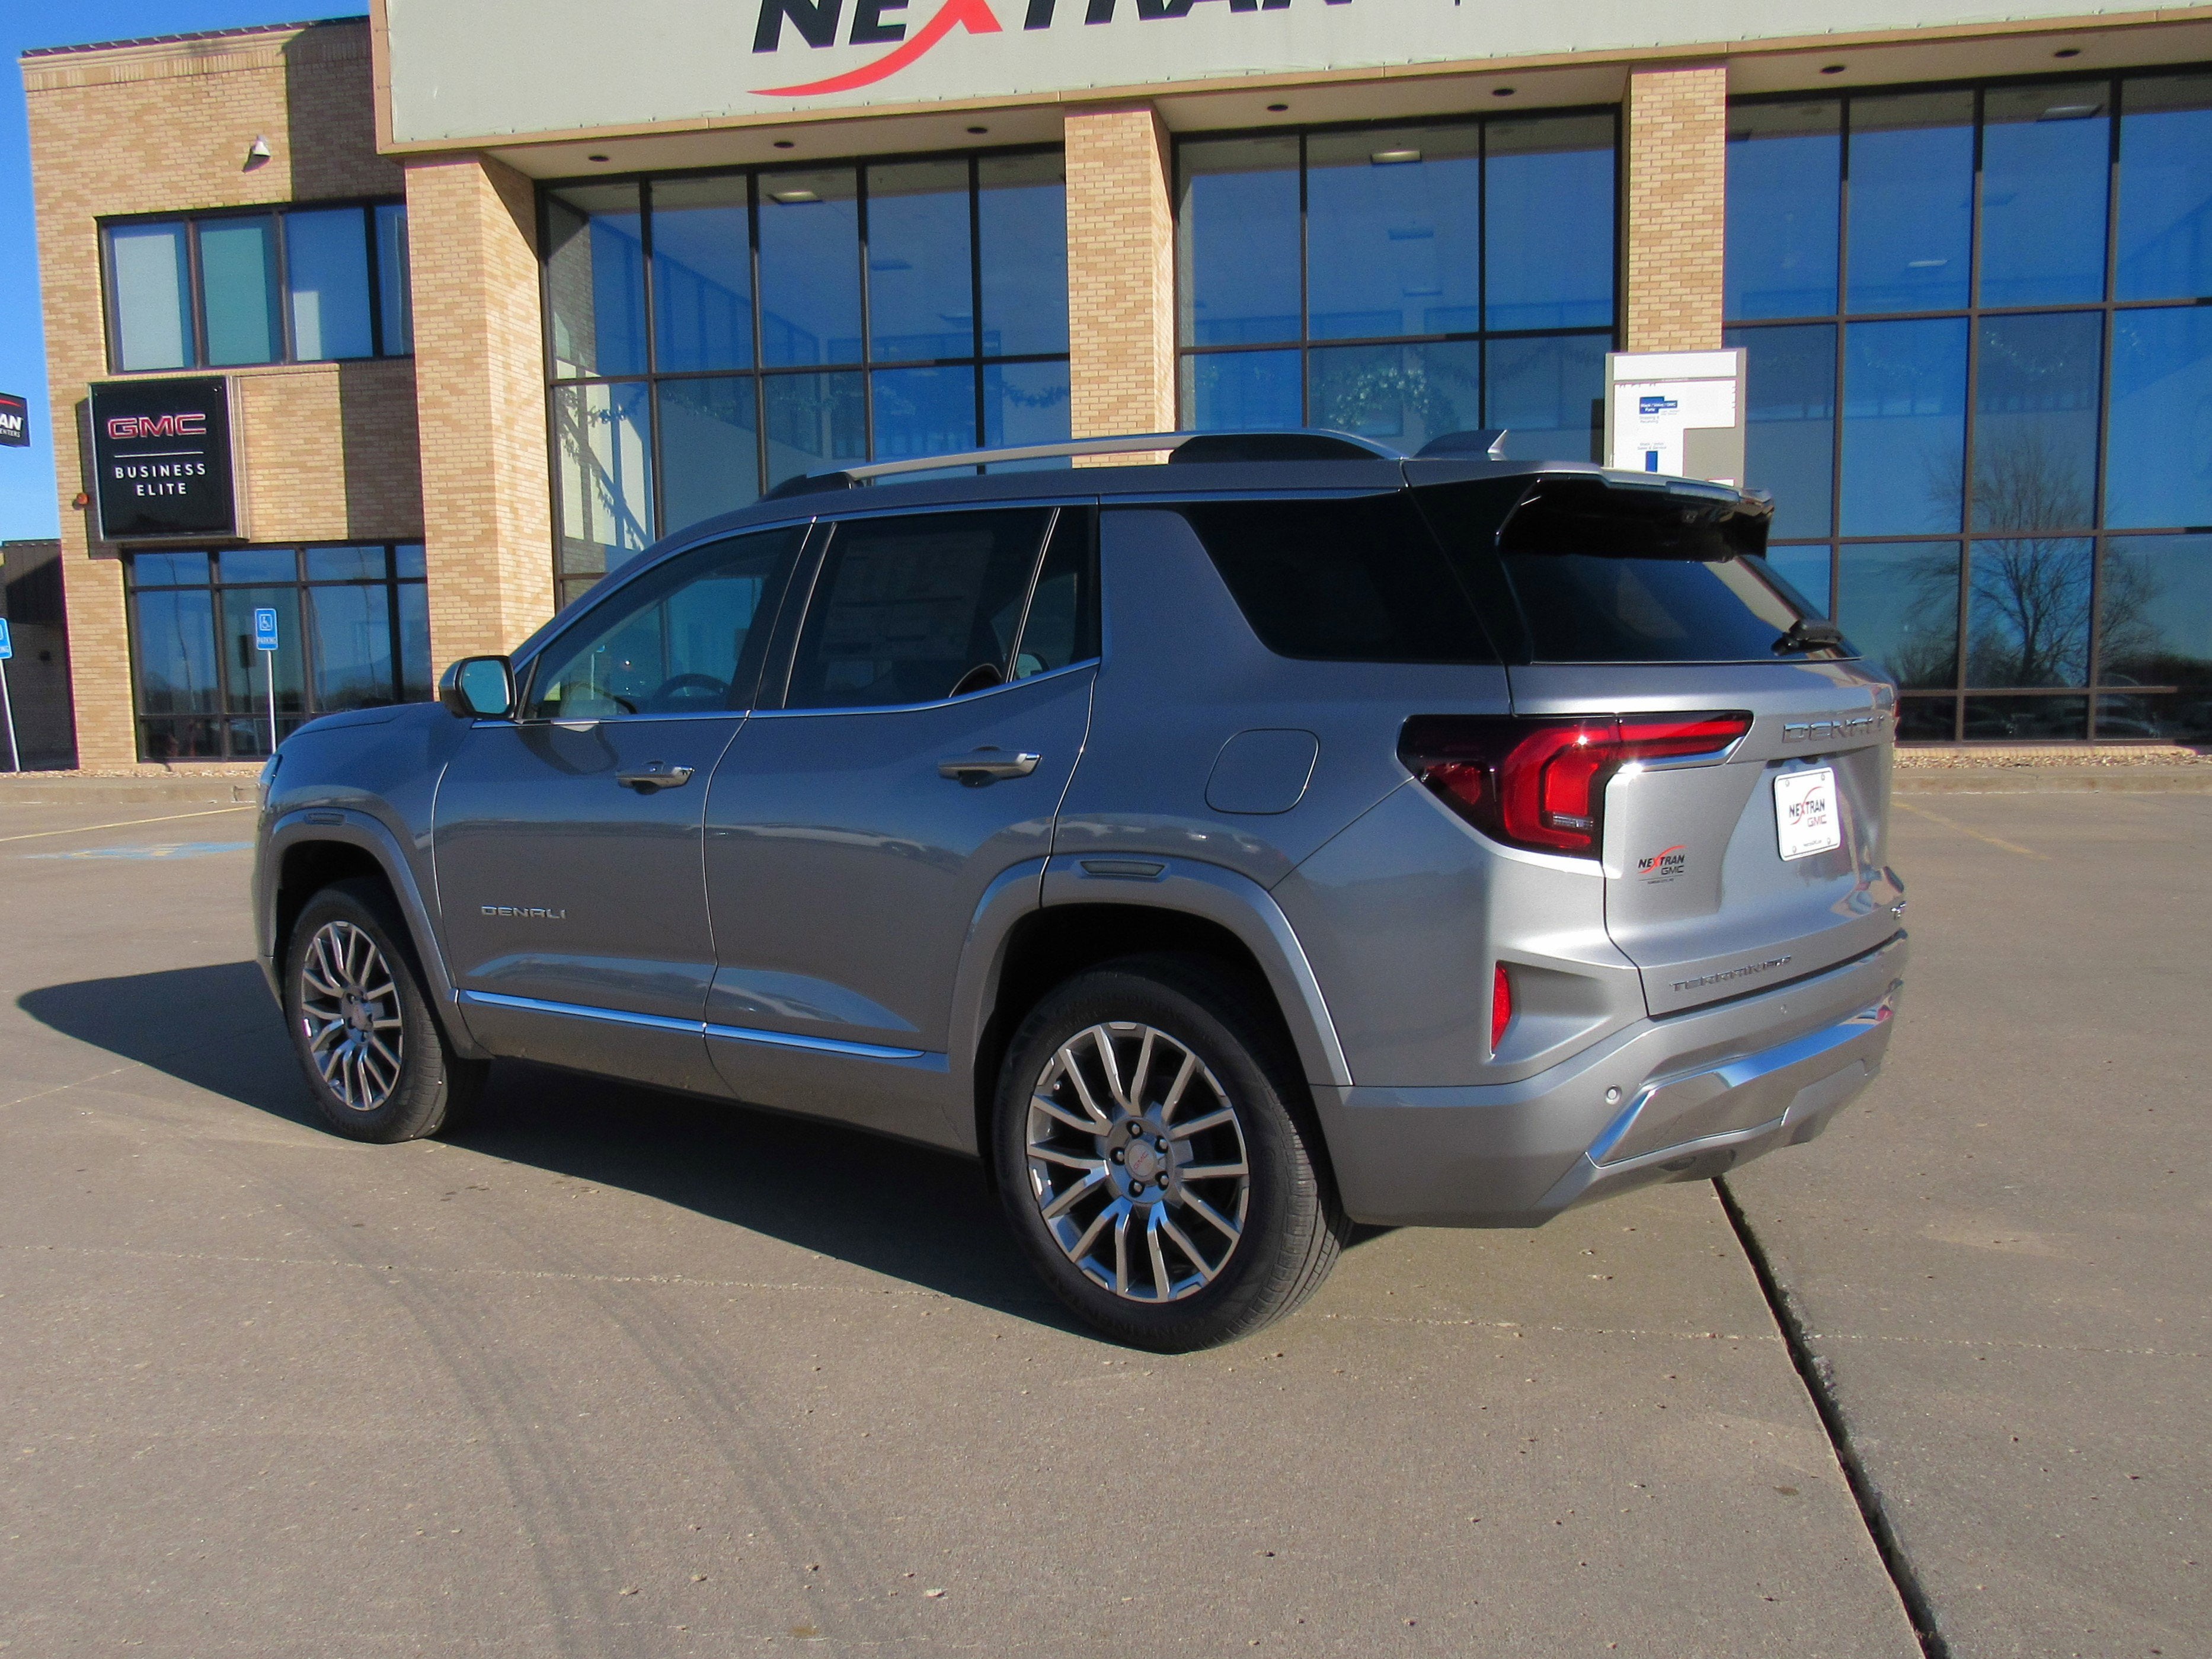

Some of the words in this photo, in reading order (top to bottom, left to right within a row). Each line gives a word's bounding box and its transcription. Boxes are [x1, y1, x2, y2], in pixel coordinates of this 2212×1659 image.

[108, 413, 207, 440] GMC
[114, 462, 206, 480] BUSINESS
[136, 482, 187, 497] ELITE
[1788, 798, 1826, 819] NEXTRAN
[1807, 814, 1827, 827] GMC
[1638, 854, 1686, 869] NEXTRAN
[1661, 865, 1685, 875] GMC
[481, 904, 567, 919] DENALI
